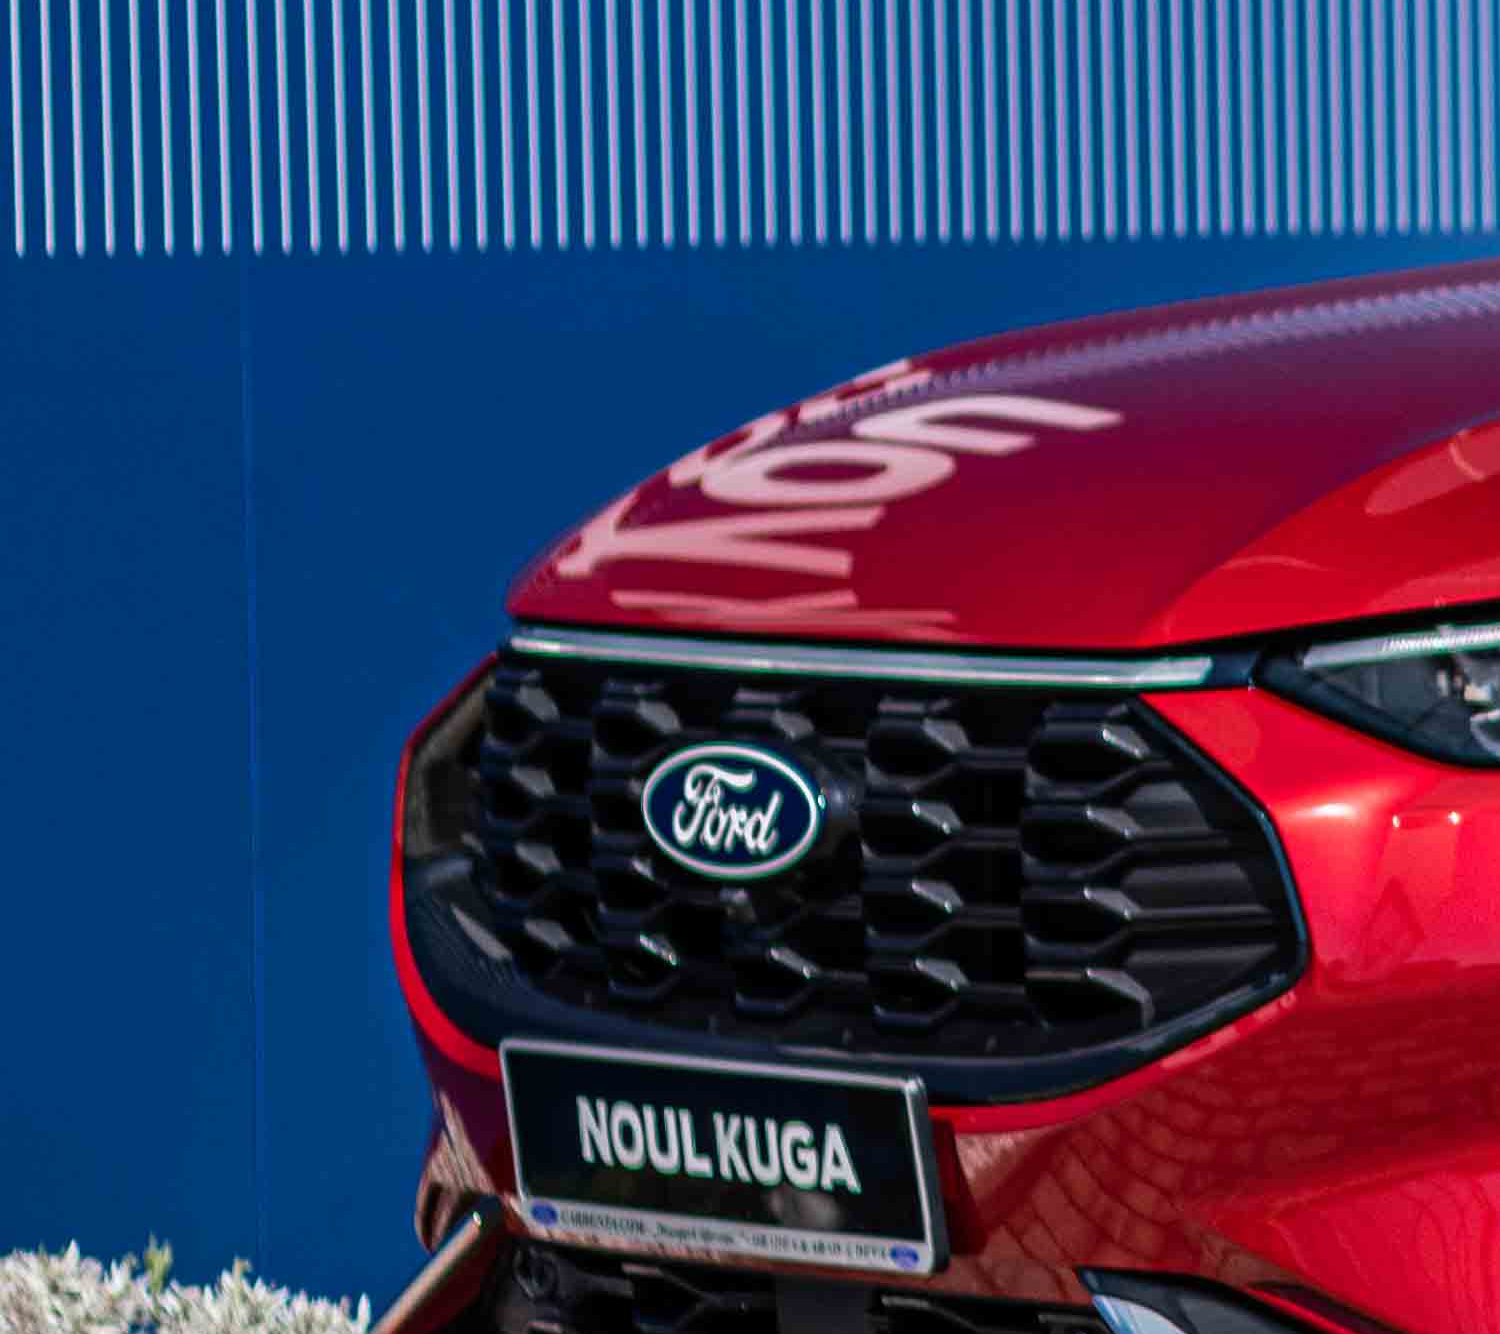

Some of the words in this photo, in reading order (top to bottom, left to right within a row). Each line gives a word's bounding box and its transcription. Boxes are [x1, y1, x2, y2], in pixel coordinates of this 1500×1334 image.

[674, 763, 781, 856] Ford
[575, 1094, 714, 1179] NOUL
[712, 1110, 863, 1196] KUGA
